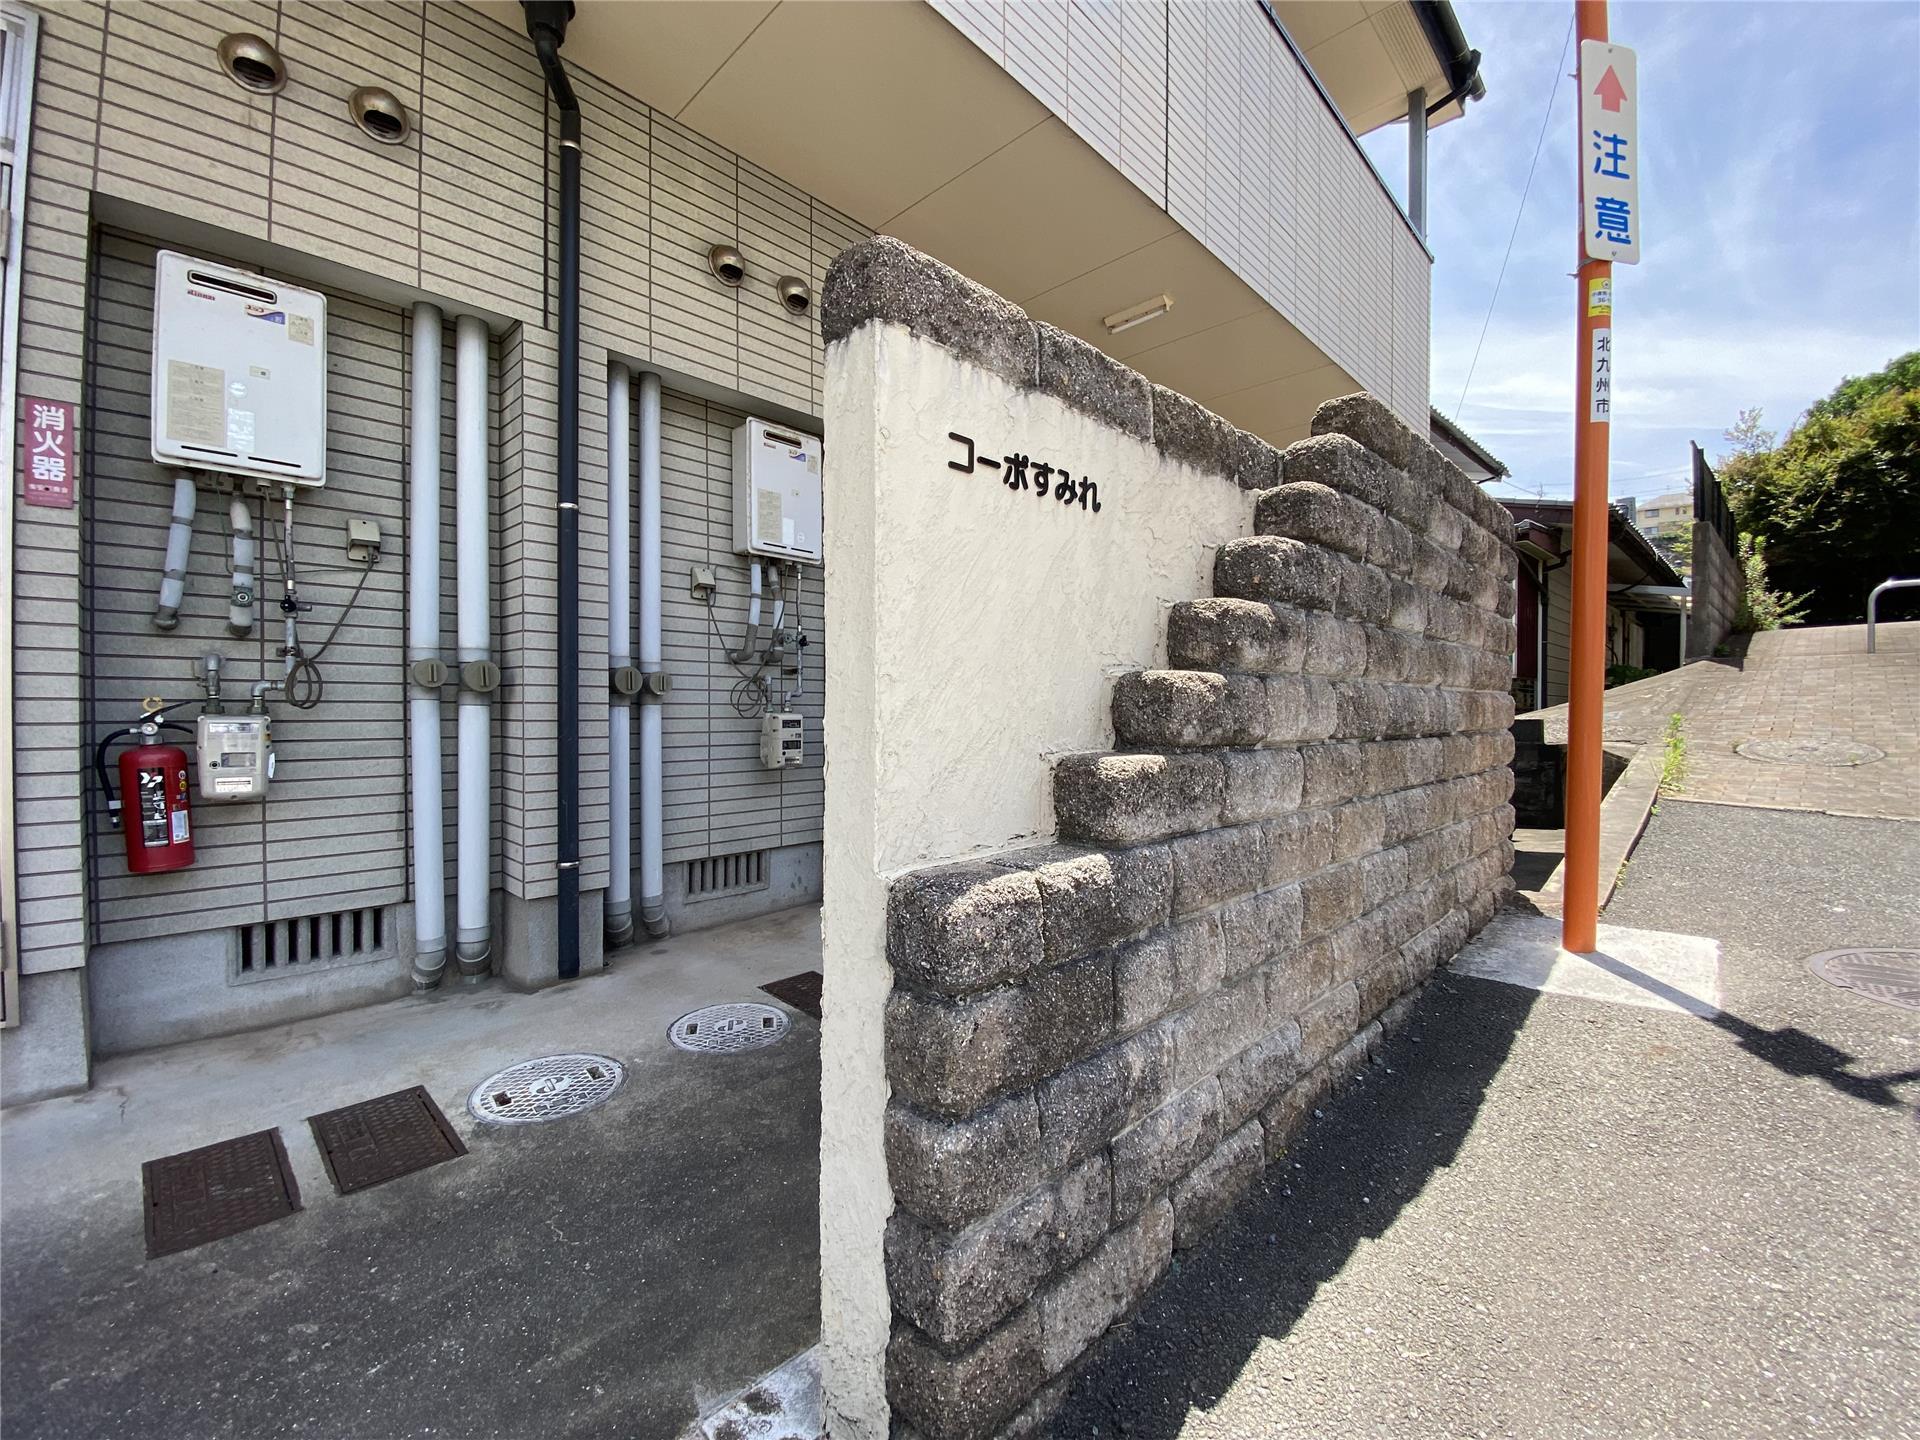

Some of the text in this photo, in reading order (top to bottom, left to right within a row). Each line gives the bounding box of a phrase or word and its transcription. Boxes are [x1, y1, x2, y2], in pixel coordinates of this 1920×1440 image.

[1593, 130, 1631, 245] 注意
[1596, 336, 1611, 413] 北九州市
[32, 404, 66, 482] 消火器
[948, 431, 1102, 513] コーポすみれ
